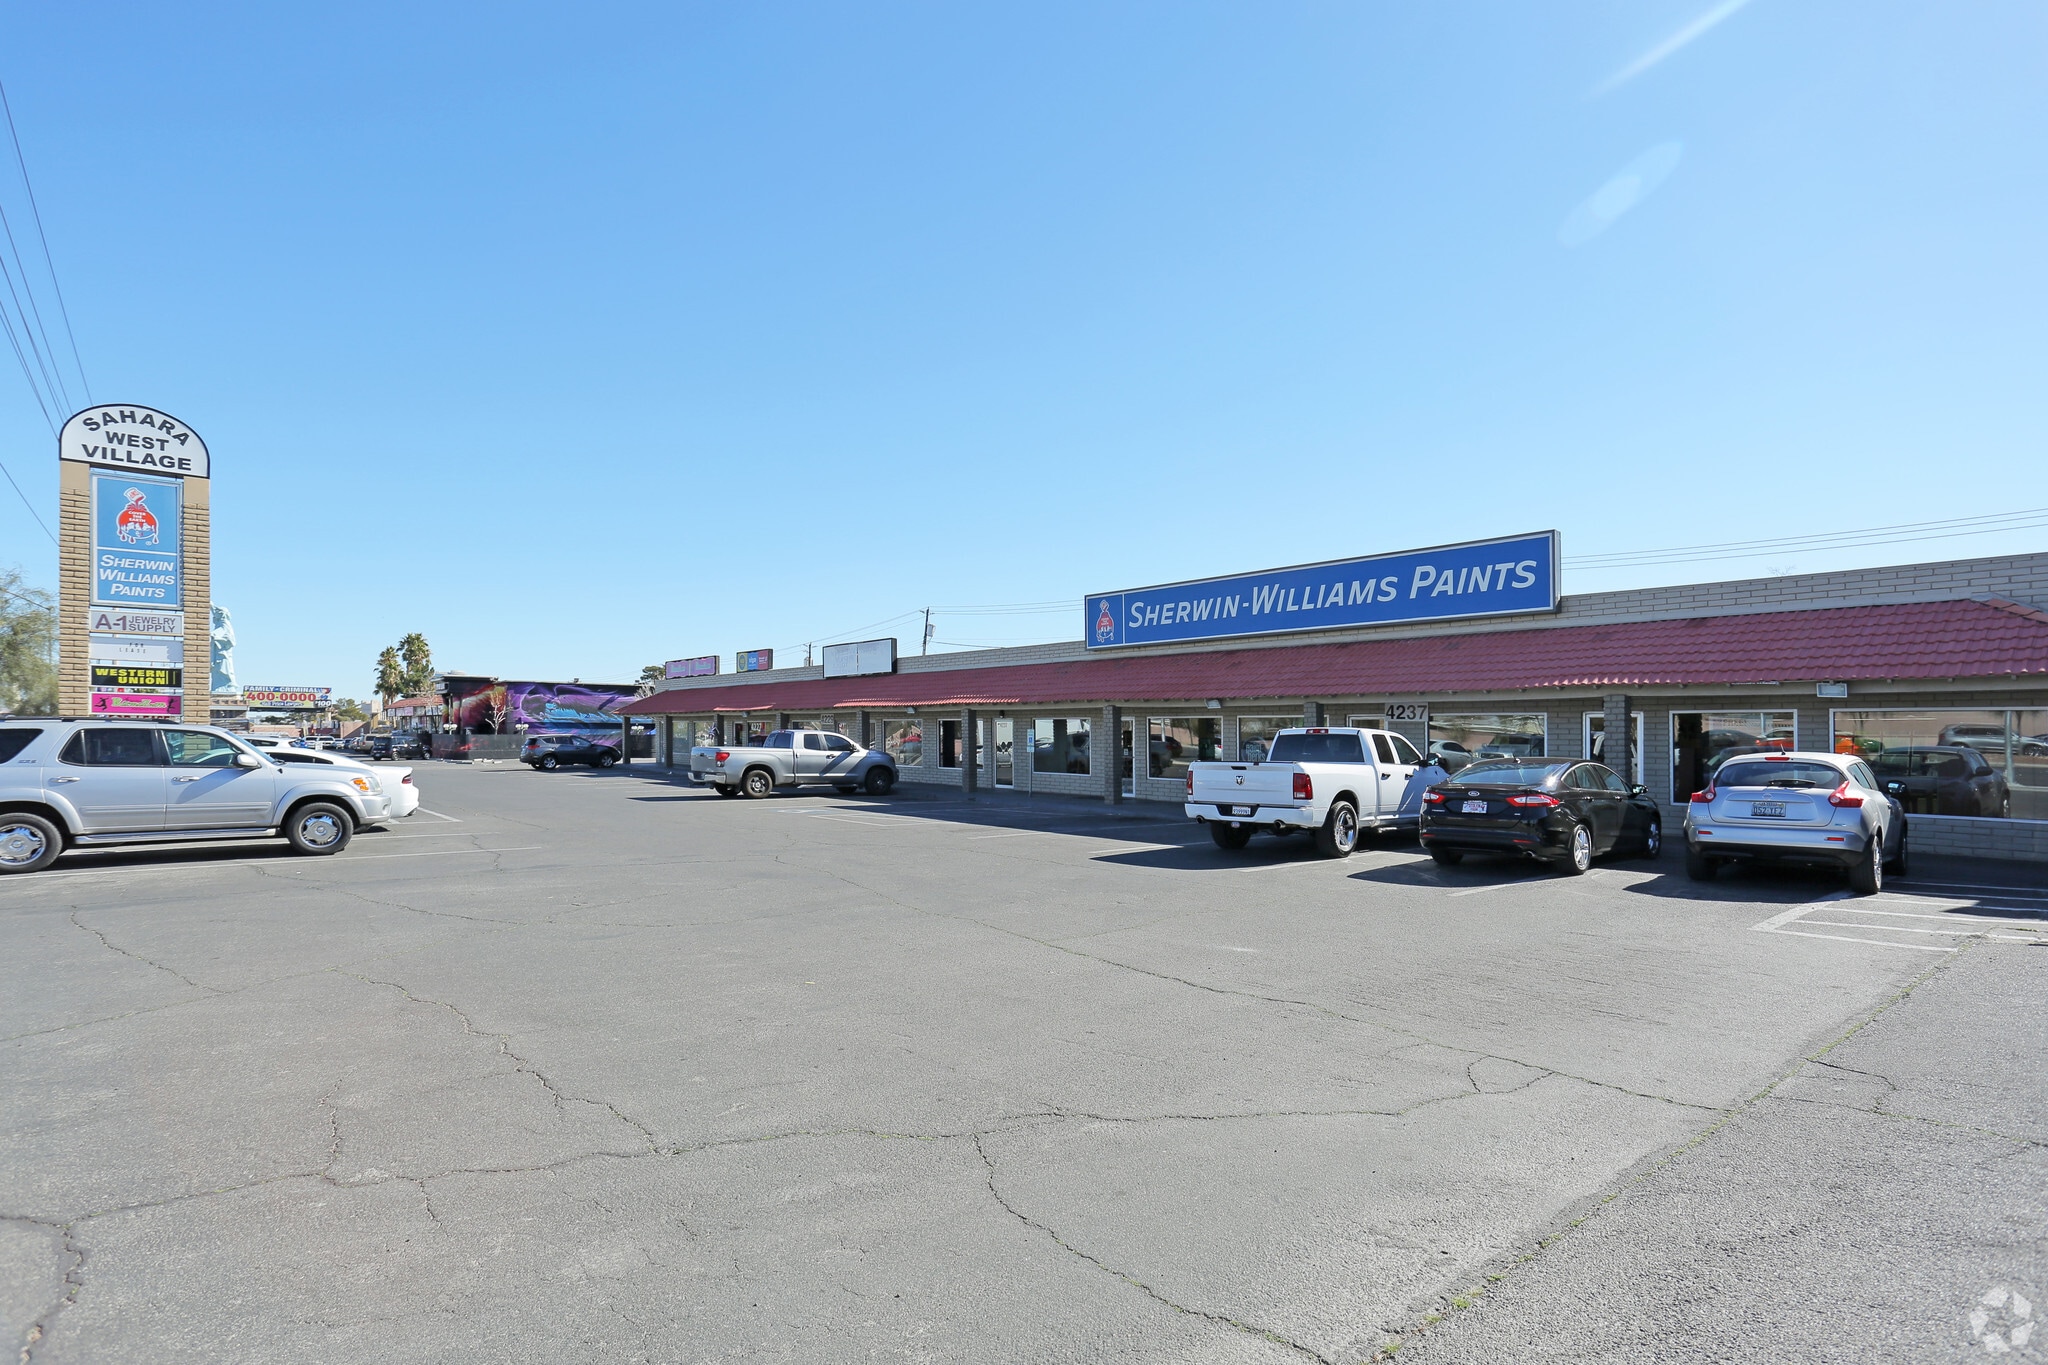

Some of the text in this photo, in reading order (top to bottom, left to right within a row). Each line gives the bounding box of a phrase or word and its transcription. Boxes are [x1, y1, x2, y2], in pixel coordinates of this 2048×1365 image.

[83, 410, 190, 446] SAHARA
[105, 430, 169, 452] WEST
[81, 443, 192, 471] VILLAGE
[100, 555, 174, 571] SHERWIN
[99, 568, 175, 585] WILLIAMS
[110, 583, 166, 598] PAINTS
[1128, 560, 1537, 628] SHERWIN-WILLIAMS PAINTS
[95, 614, 127, 631] A-1
[128, 616, 176, 626] JEWELRY
[128, 623, 176, 633] SUPPLY
[95, 668, 165, 677] WESTERN
[117, 676, 166, 685] UNION
[246, 692, 317, 702] 400-0000
[1385, 704, 1428, 720] 4237
